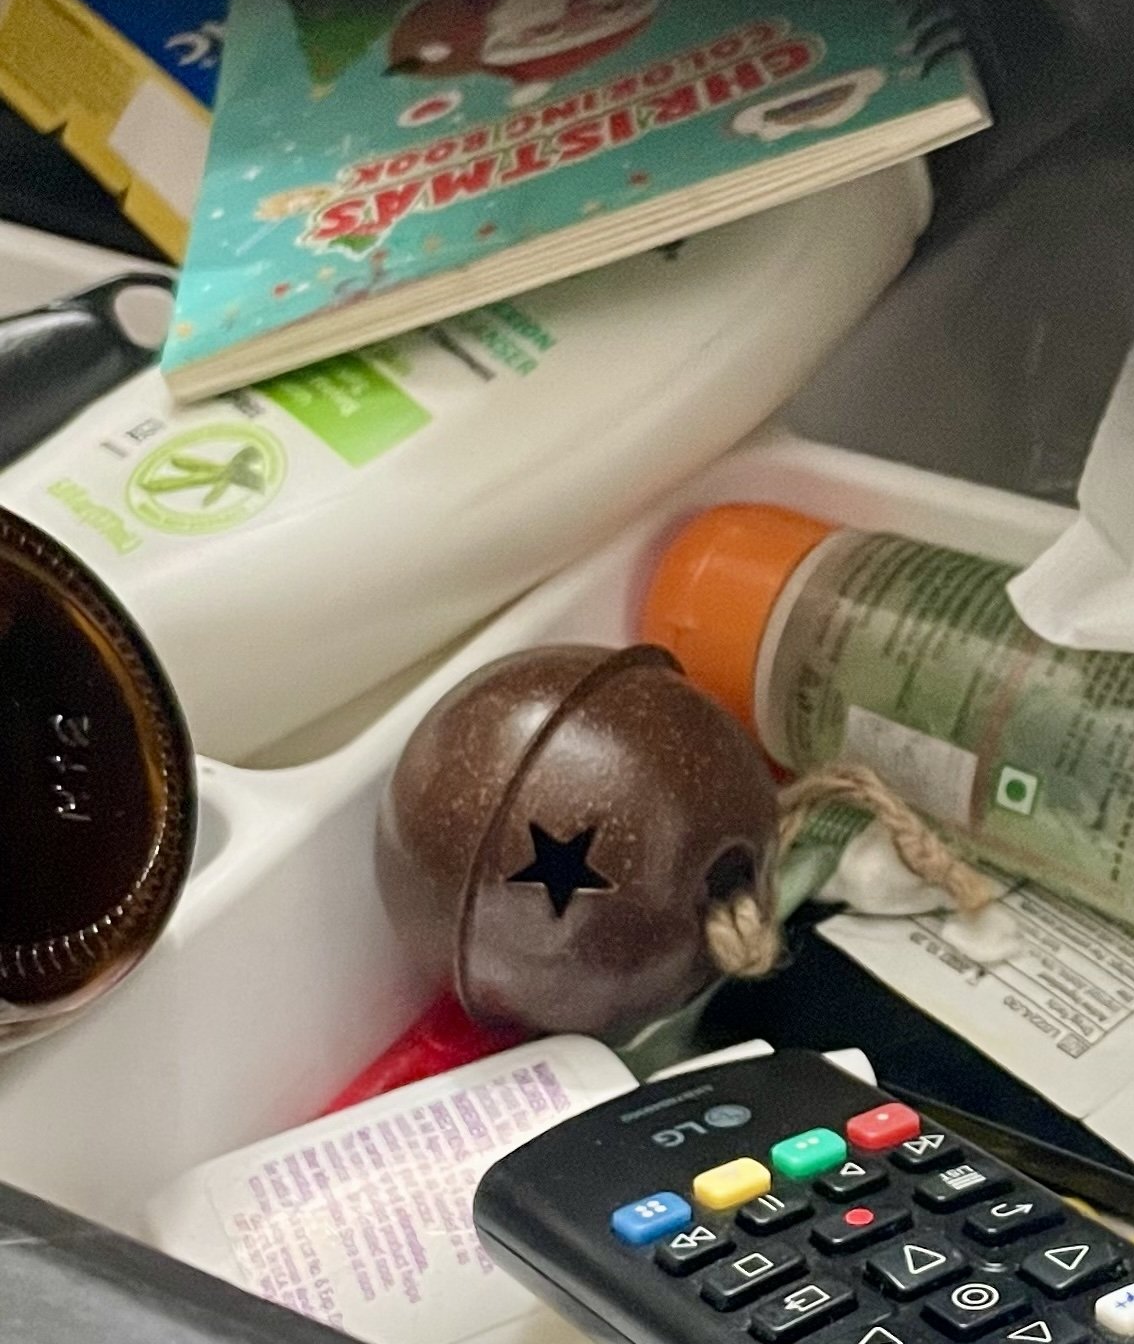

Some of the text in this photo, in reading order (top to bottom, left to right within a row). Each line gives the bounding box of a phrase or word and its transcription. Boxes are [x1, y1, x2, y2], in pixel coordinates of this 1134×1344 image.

[309, 38, 816, 242] CHRISTMAS
[352, 126, 487, 190] BOOK
[651, 1118, 712, 1149] LG
[938, 1164, 973, 1186] LIST
